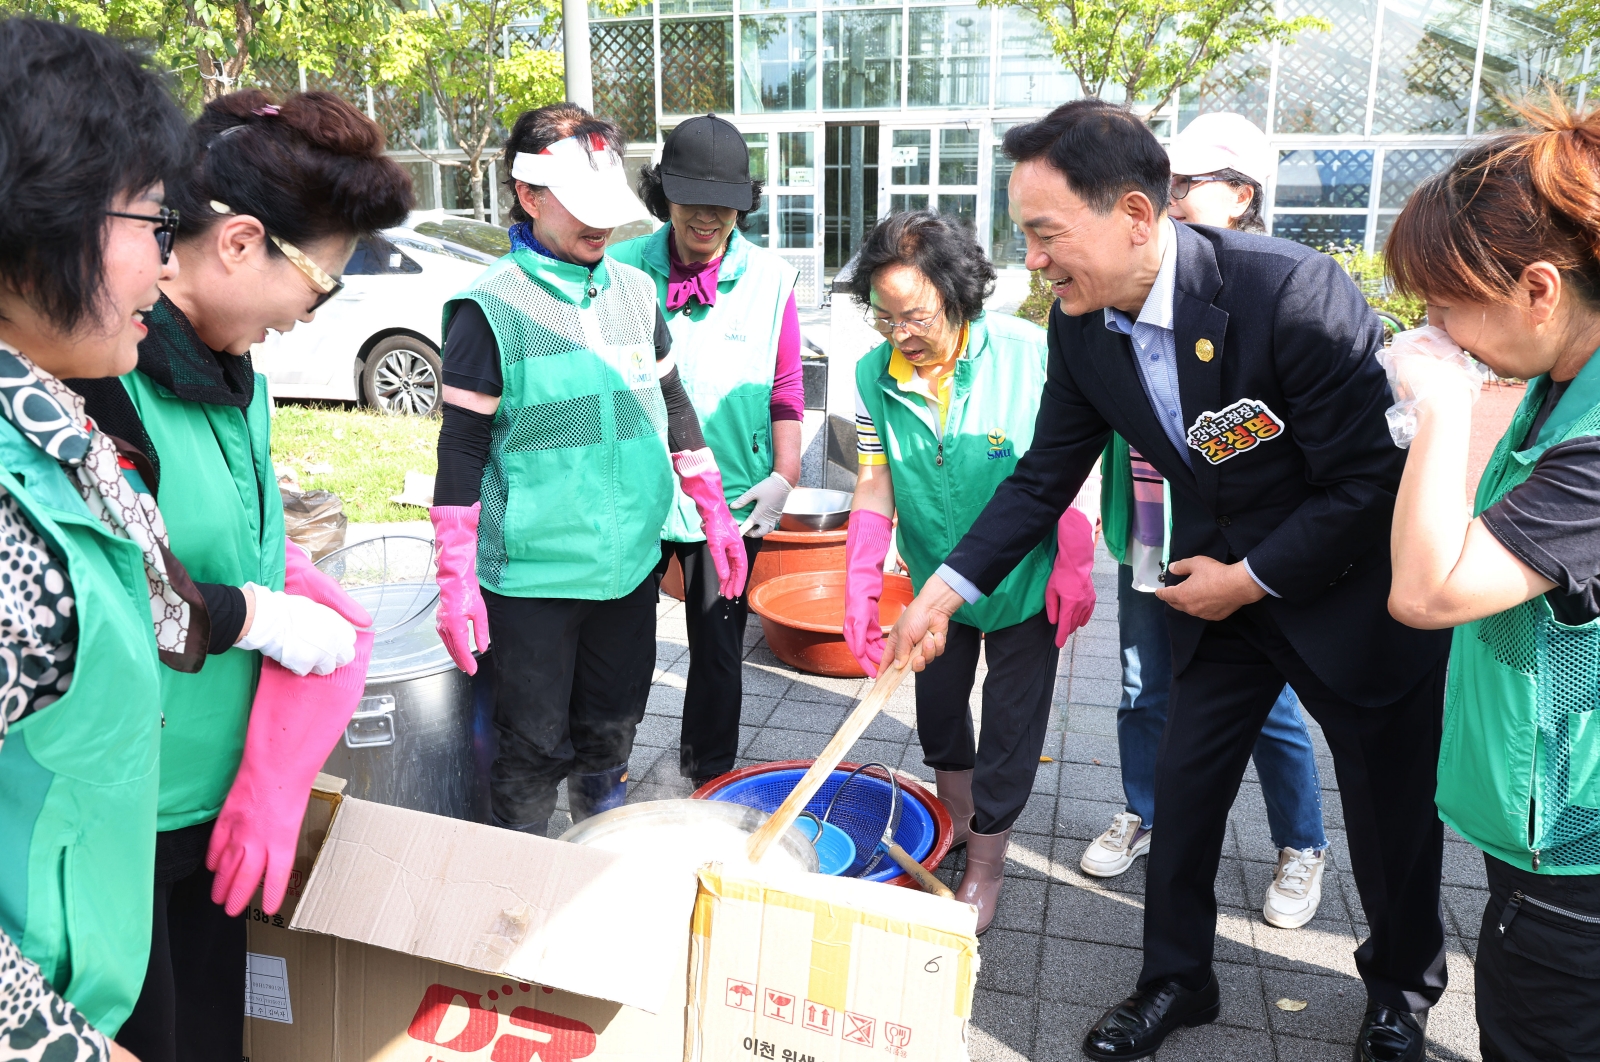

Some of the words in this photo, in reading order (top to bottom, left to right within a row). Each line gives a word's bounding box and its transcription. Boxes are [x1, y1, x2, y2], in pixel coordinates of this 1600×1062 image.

[724, 333, 746, 342] SMU
[1193, 404, 1255, 441] 강남구청장
[1200, 412, 1281, 462] 조성명
[987, 449, 1011, 460] SMU
[923, 955, 943, 973] 6
[742, 1036, 776, 1061] 이천
